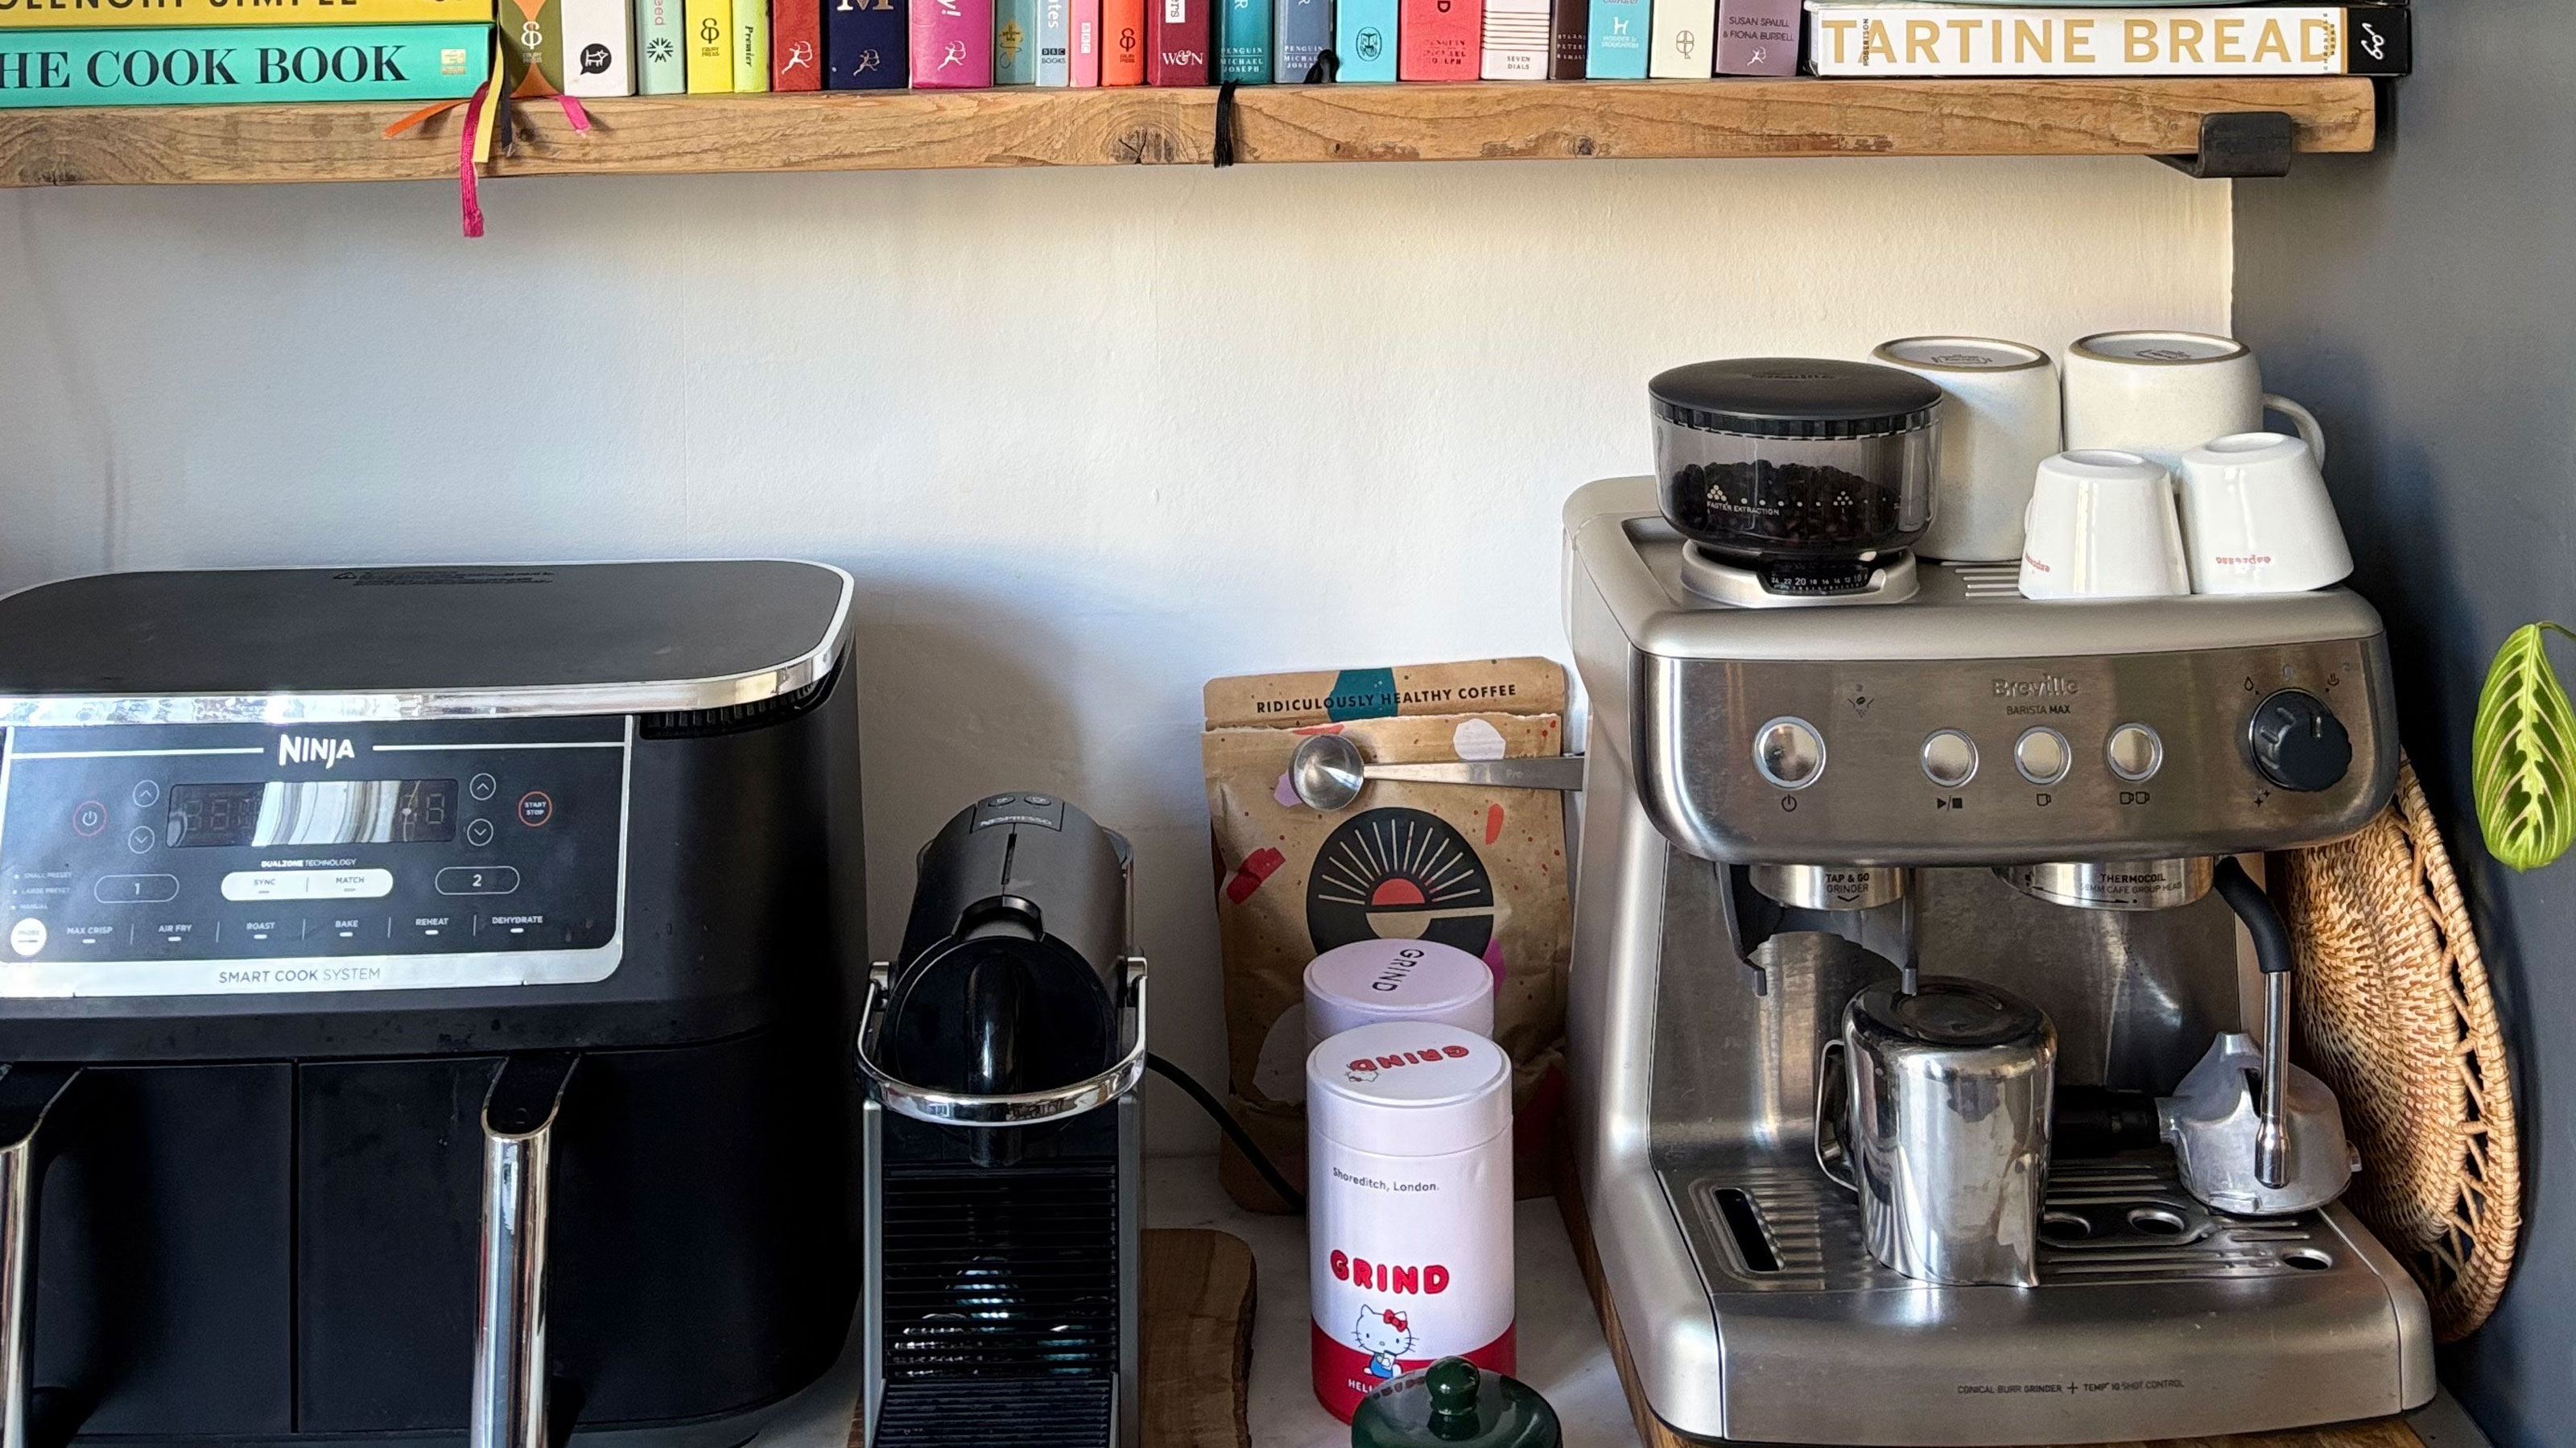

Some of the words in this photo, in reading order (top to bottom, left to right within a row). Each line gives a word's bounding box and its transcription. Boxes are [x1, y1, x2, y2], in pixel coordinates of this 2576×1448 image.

[1728, 16, 1758, 26] SUSAN
[1761, 18, 1790, 27] SPAULL
[1731, 31, 1757, 40] FIONA
[1760, 31, 1794, 41] BURRELL
[1821, 19, 2095, 64] TARTINE
[2124, 18, 2337, 64] BREAD
[745, 25, 754, 67] Premier
[1221, 47, 1262, 55] PENGUIN
[1162, 49, 1203, 66] W&N
[87, 48, 241, 88] COOK
[254, 45, 410, 85] BOOK
[1707, 501, 1732, 512] FASTER
[1734, 505, 1780, 516] EXTRACTION
[1794, 577, 1806, 586] 20
[1991, 674, 2079, 698] Breville
[1256, 693, 1374, 714] RIDICULOUSLY
[1381, 688, 1452, 706] HEALTHY
[1458, 683, 1517, 700] COFFEE
[2006, 704, 2047, 716] BARISTA
[2049, 703, 2071, 715] MAX
[279, 733, 355, 769] NINJA
[524, 801, 547, 809] START
[261, 860, 303, 868] DUALZONE
[305, 858, 357, 867] TECHNOLOGY
[254, 878, 276, 886] SYNC
[336, 876, 365, 885] MATCH
[473, 874, 483, 887] 2
[1826, 873, 1845, 883] TAP
[1847, 874, 1855, 883] &
[1857, 873, 1870, 882] GO
[2100, 873, 2166, 883] THERMOCOIL
[134, 882, 141, 895] 1
[1826, 883, 1869, 893] GRINDER
[2132, 885, 2161, 894] GROUP
[246, 922, 275, 930] ROAST
[335, 920, 359, 928] BAKE
[415, 918, 449, 926] REHEAT
[492, 915, 543, 925] DEHYDRATE
[67, 926, 86, 934] MAX
[88, 926, 113, 934] CRISP
[158, 925, 174, 933] AIR
[175, 924, 192, 933] FRY
[219, 971, 270, 984] SMART
[275, 968, 318, 983] COOK
[323, 967, 382, 981] SYSTEM
[1372, 948, 1425, 992] GRIND
[1348, 1045, 1470, 1072] GRIND
[1332, 1166, 1391, 1193] Shoreditch,
[1393, 1181, 1440, 1193] London.
[1330, 1249, 1450, 1295] GRIND
[1957, 1385, 1996, 1394] CONICAL
[1997, 1385, 2021, 1393] BURR
[2024, 1384, 2062, 1393] GRINDER
[2121, 1381, 2144, 1390] SHOT
[2145, 1380, 2185, 1389] CONTROL
